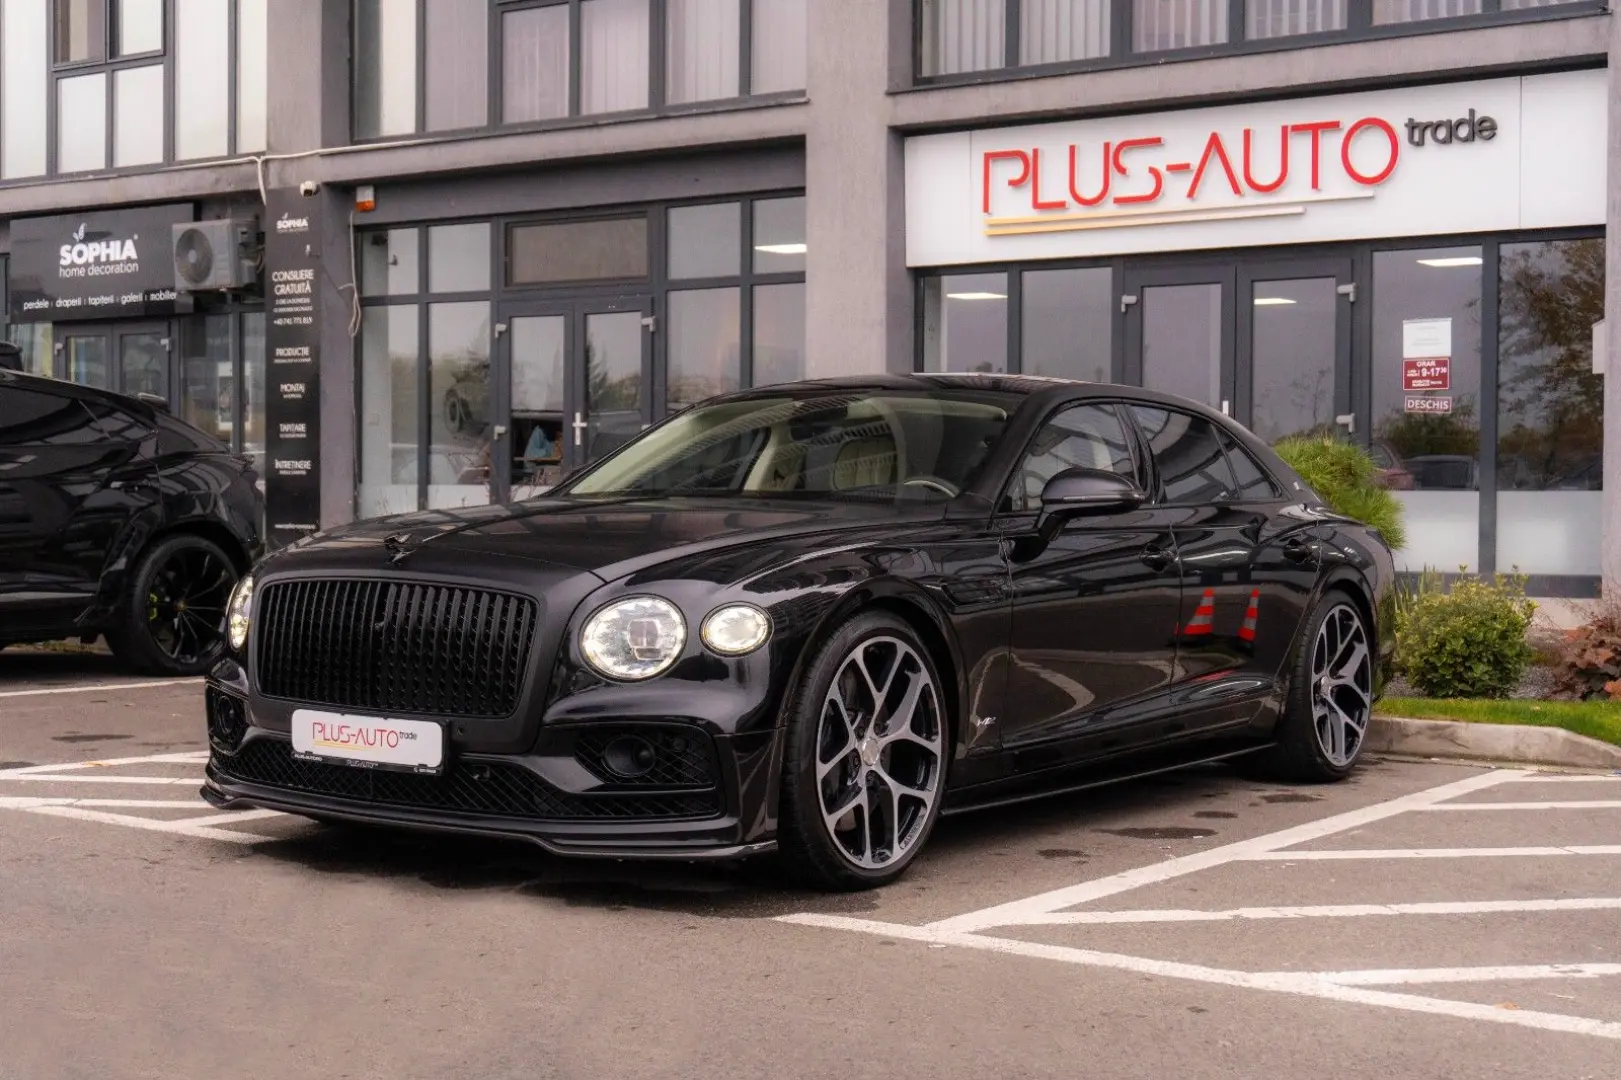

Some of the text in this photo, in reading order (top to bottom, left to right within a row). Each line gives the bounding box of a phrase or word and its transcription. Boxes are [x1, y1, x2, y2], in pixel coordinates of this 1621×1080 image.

[983, 108, 1497, 214] PLUS-AUTO trade
[277, 218, 308, 229] SOPHIA
[59, 239, 138, 266] SOPHIA
[59, 261, 139, 278] home decoration
[272, 269, 314, 282] CONSILIERE
[24, 299, 49, 311] perdele
[56, 297, 81, 309] draperii
[121, 292, 143, 305] galerii
[150, 290, 177, 301] mobilier
[280, 383, 305, 393] MONTAJ
[1407, 399, 1449, 410] DESCHIS
[312, 721, 418, 748] PLUS-AUTO trade
